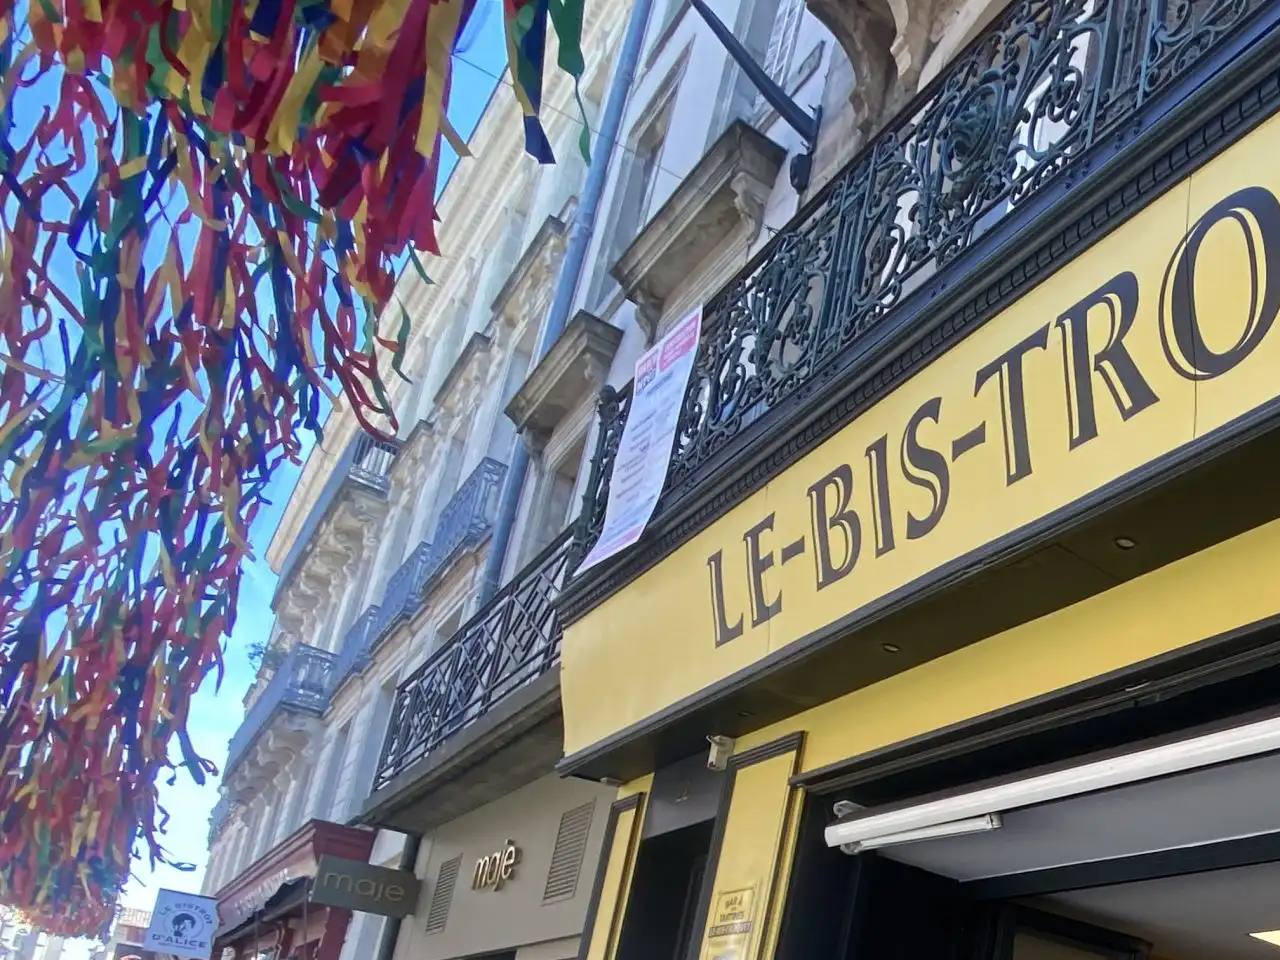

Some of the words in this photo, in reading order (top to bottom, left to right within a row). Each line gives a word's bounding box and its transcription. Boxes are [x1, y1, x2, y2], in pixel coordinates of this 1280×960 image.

[324, 870, 406, 901] maje
[174, 902, 213, 924] BISTROT
[152, 934, 208, 949] D'ALICE
